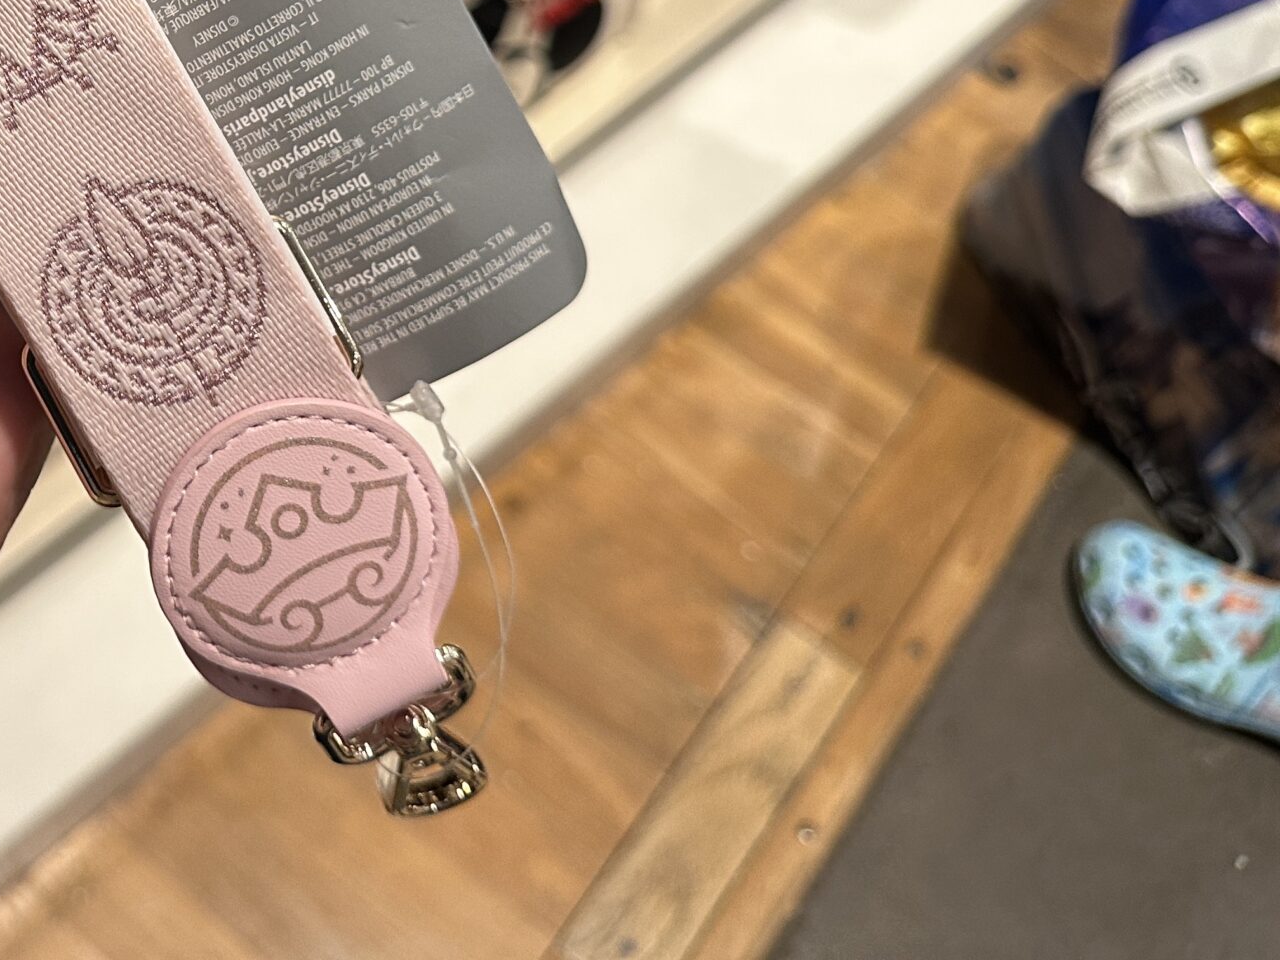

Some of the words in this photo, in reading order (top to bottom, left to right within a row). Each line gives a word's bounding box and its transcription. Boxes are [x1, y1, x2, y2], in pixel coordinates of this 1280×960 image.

[253, 1, 303, 36] CORRETTO
[307, 11, 319, 25] IT
[192, 20, 228, 48] DISNEY
[266, 23, 300, 47] VISITA
[355, 24, 369, 38] IN
[185, 28, 255, 73] SMALTIMENTO
[272, 39, 312, 69] LANTAU
[327, 31, 358, 55] HONG
[190, 40, 269, 89] DISNEYSTORE.IT
[299, 48, 330, 71] KONG
[380, 54, 394, 70] BP
[233, 61, 273, 87] ISLAND,
[261, 69, 293, 93] HONG
[360, 63, 380, 81] 100
[380, 60, 414, 89] DISNEY
[204, 82, 235, 105] HONG
[233, 85, 264, 107] KONG
[322, 79, 353, 104] 77777
[348, 81, 381, 107] PARKS
[232, 97, 322, 151] MARNE-LA-VALLÉE
[324, 105, 341, 120] EN
[286, 113, 327, 141] FRANCE
[252, 138, 280, 159] EURO
[396, 150, 440, 183] POSTBUS
[373, 177, 397, 194] 406,
[418, 174, 432, 188] IN
[350, 188, 376, 208] 2130
[368, 181, 420, 216] EUROPEAN
[401, 195, 435, 220] QUEEN
[433, 190, 442, 202] 3
[335, 201, 351, 216] AK
[440, 202, 454, 216] IN
[294, 208, 338, 237] HOOFDD
[335, 210, 370, 233] UNION
[354, 214, 402, 245] CAROLINE
[406, 209, 443, 235] UNITED
[502, 225, 515, 238] IN
[539, 221, 552, 235] CE
[316, 238, 356, 263] STREET,
[359, 229, 408, 260] KINGDOM
[484, 232, 505, 249] U.S.
[503, 229, 542, 261] PRODUIT
[444, 248, 480, 275] DISNEY
[527, 243, 550, 262] THIS
[330, 257, 352, 274] THE
[480, 255, 505, 276] PEUT
[487, 256, 531, 290] PRODUCT
[350, 291, 366, 305] CA
[376, 268, 445, 309] MERCHANDISE
[466, 283, 489, 302] MAY
[451, 295, 467, 310] BE
[407, 302, 454, 332] SUPPLIED
[360, 321, 382, 338] SUR
[375, 331, 397, 348] THE
[395, 326, 409, 338] IN
